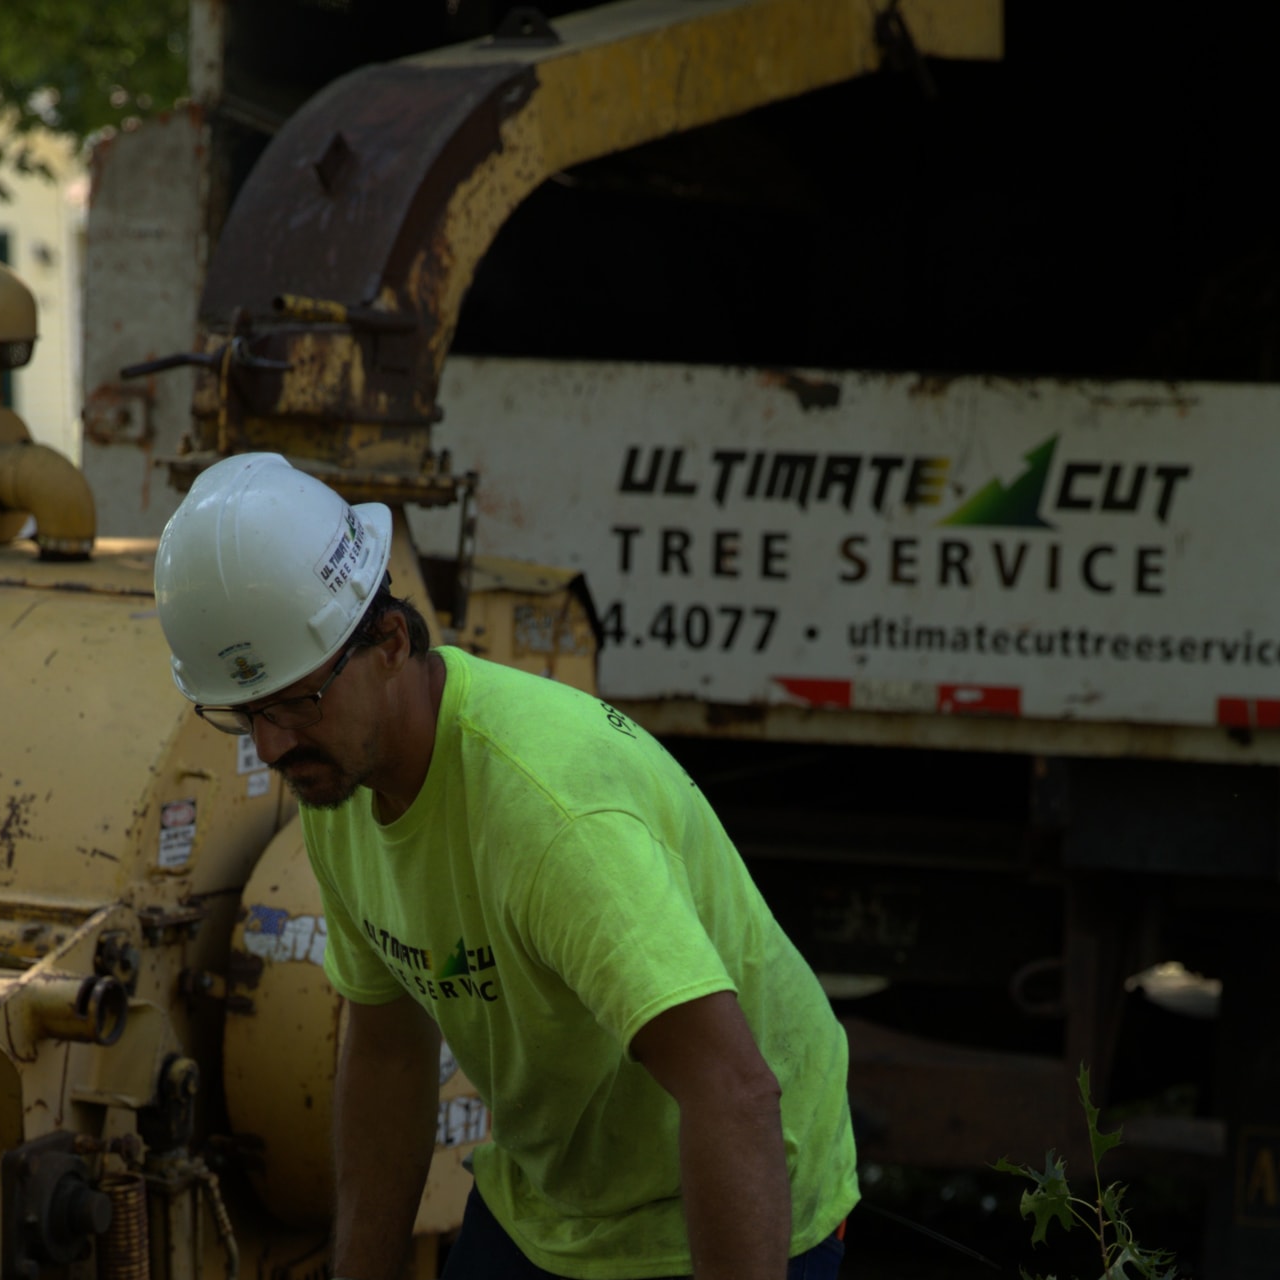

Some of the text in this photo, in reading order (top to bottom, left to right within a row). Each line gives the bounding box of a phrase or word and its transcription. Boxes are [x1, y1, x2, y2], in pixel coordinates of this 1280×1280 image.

[618, 447, 1191, 522] ULTIMATE CUT
[328, 562, 351, 593] TREE
[613, 526, 1165, 594] TREE SERVICE
[414, 976, 498, 1002] SERVIC
